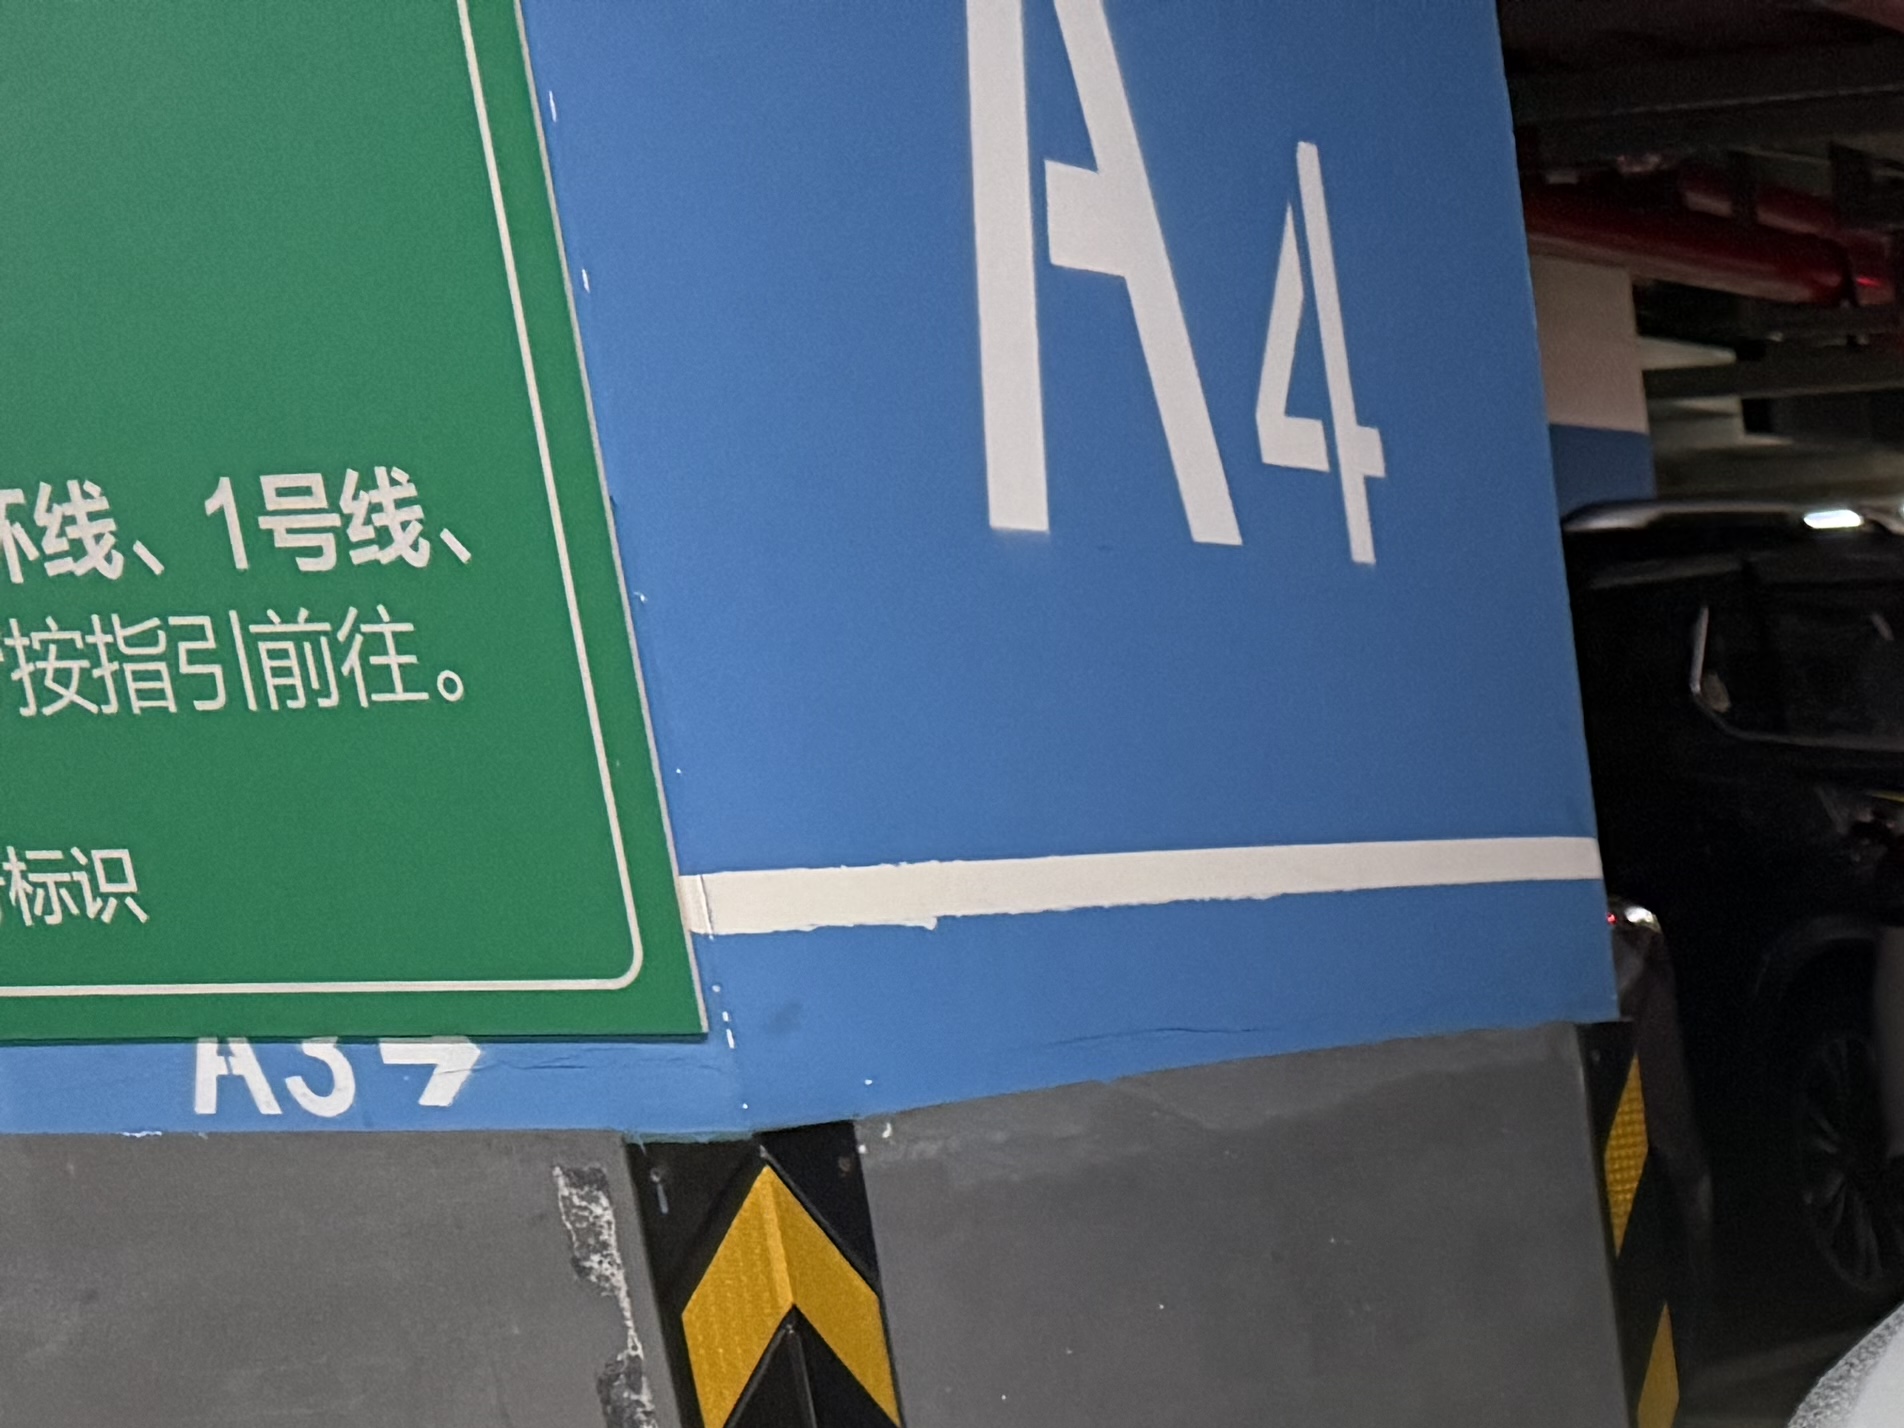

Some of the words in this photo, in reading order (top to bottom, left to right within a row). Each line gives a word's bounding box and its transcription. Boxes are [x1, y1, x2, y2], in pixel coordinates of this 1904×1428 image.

[0, 604, 465, 717] 按指引前往。
[0, 845, 150, 928] 标识
